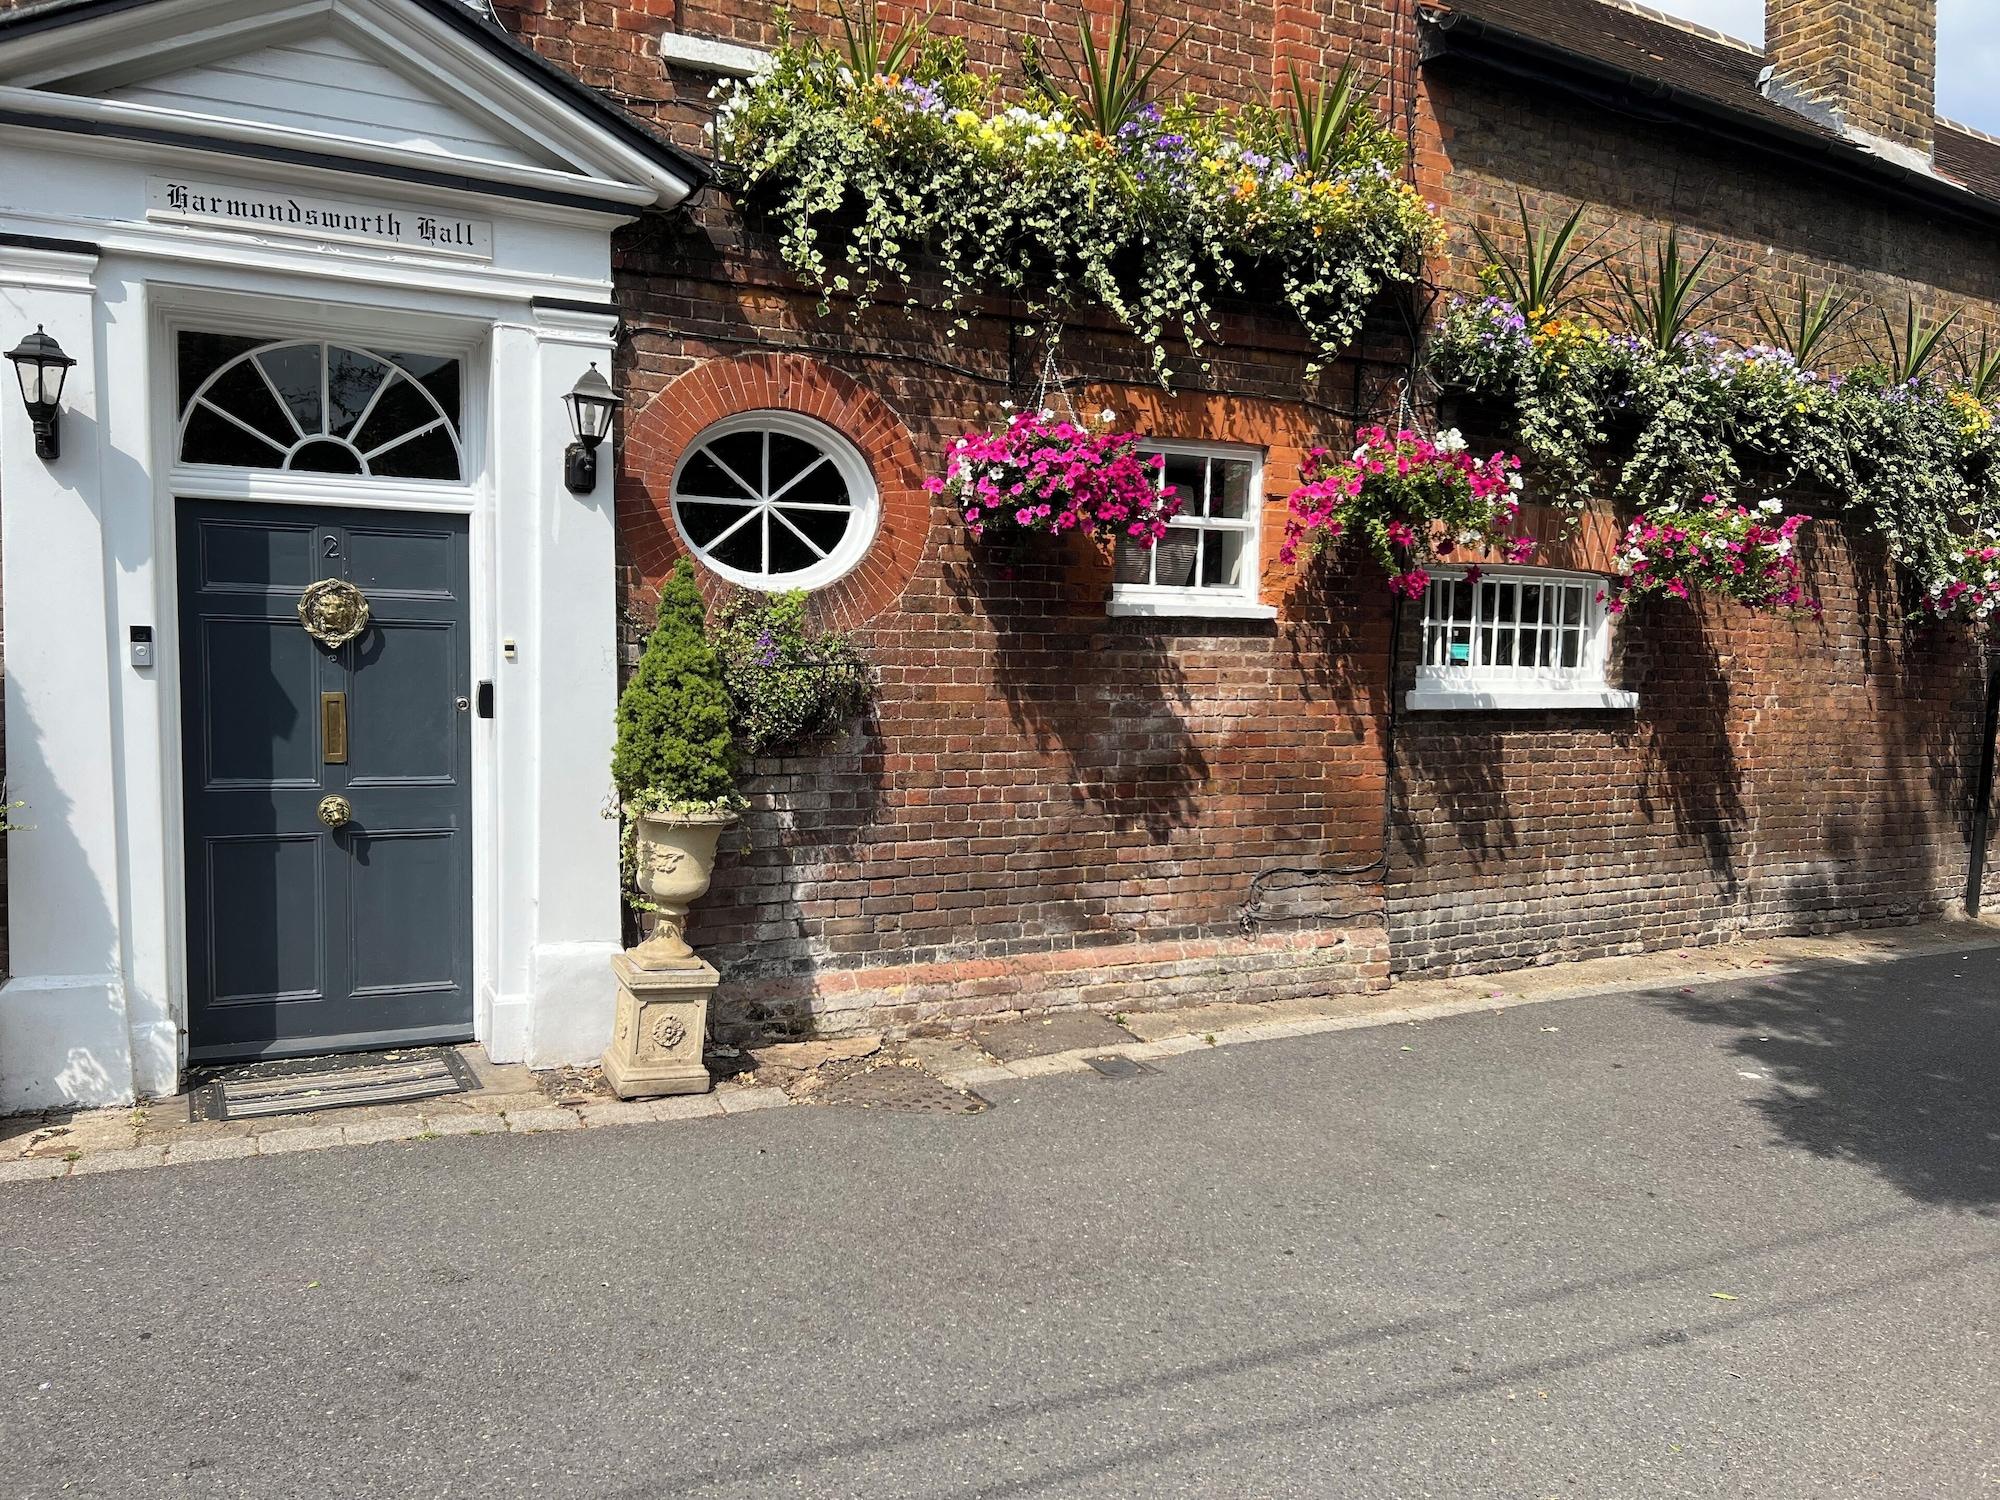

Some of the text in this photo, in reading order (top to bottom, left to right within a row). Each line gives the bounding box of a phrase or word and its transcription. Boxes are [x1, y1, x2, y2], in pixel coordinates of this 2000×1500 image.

[166, 183, 475, 247] Harmondsworth Hall
[323, 535, 339, 558] 2
